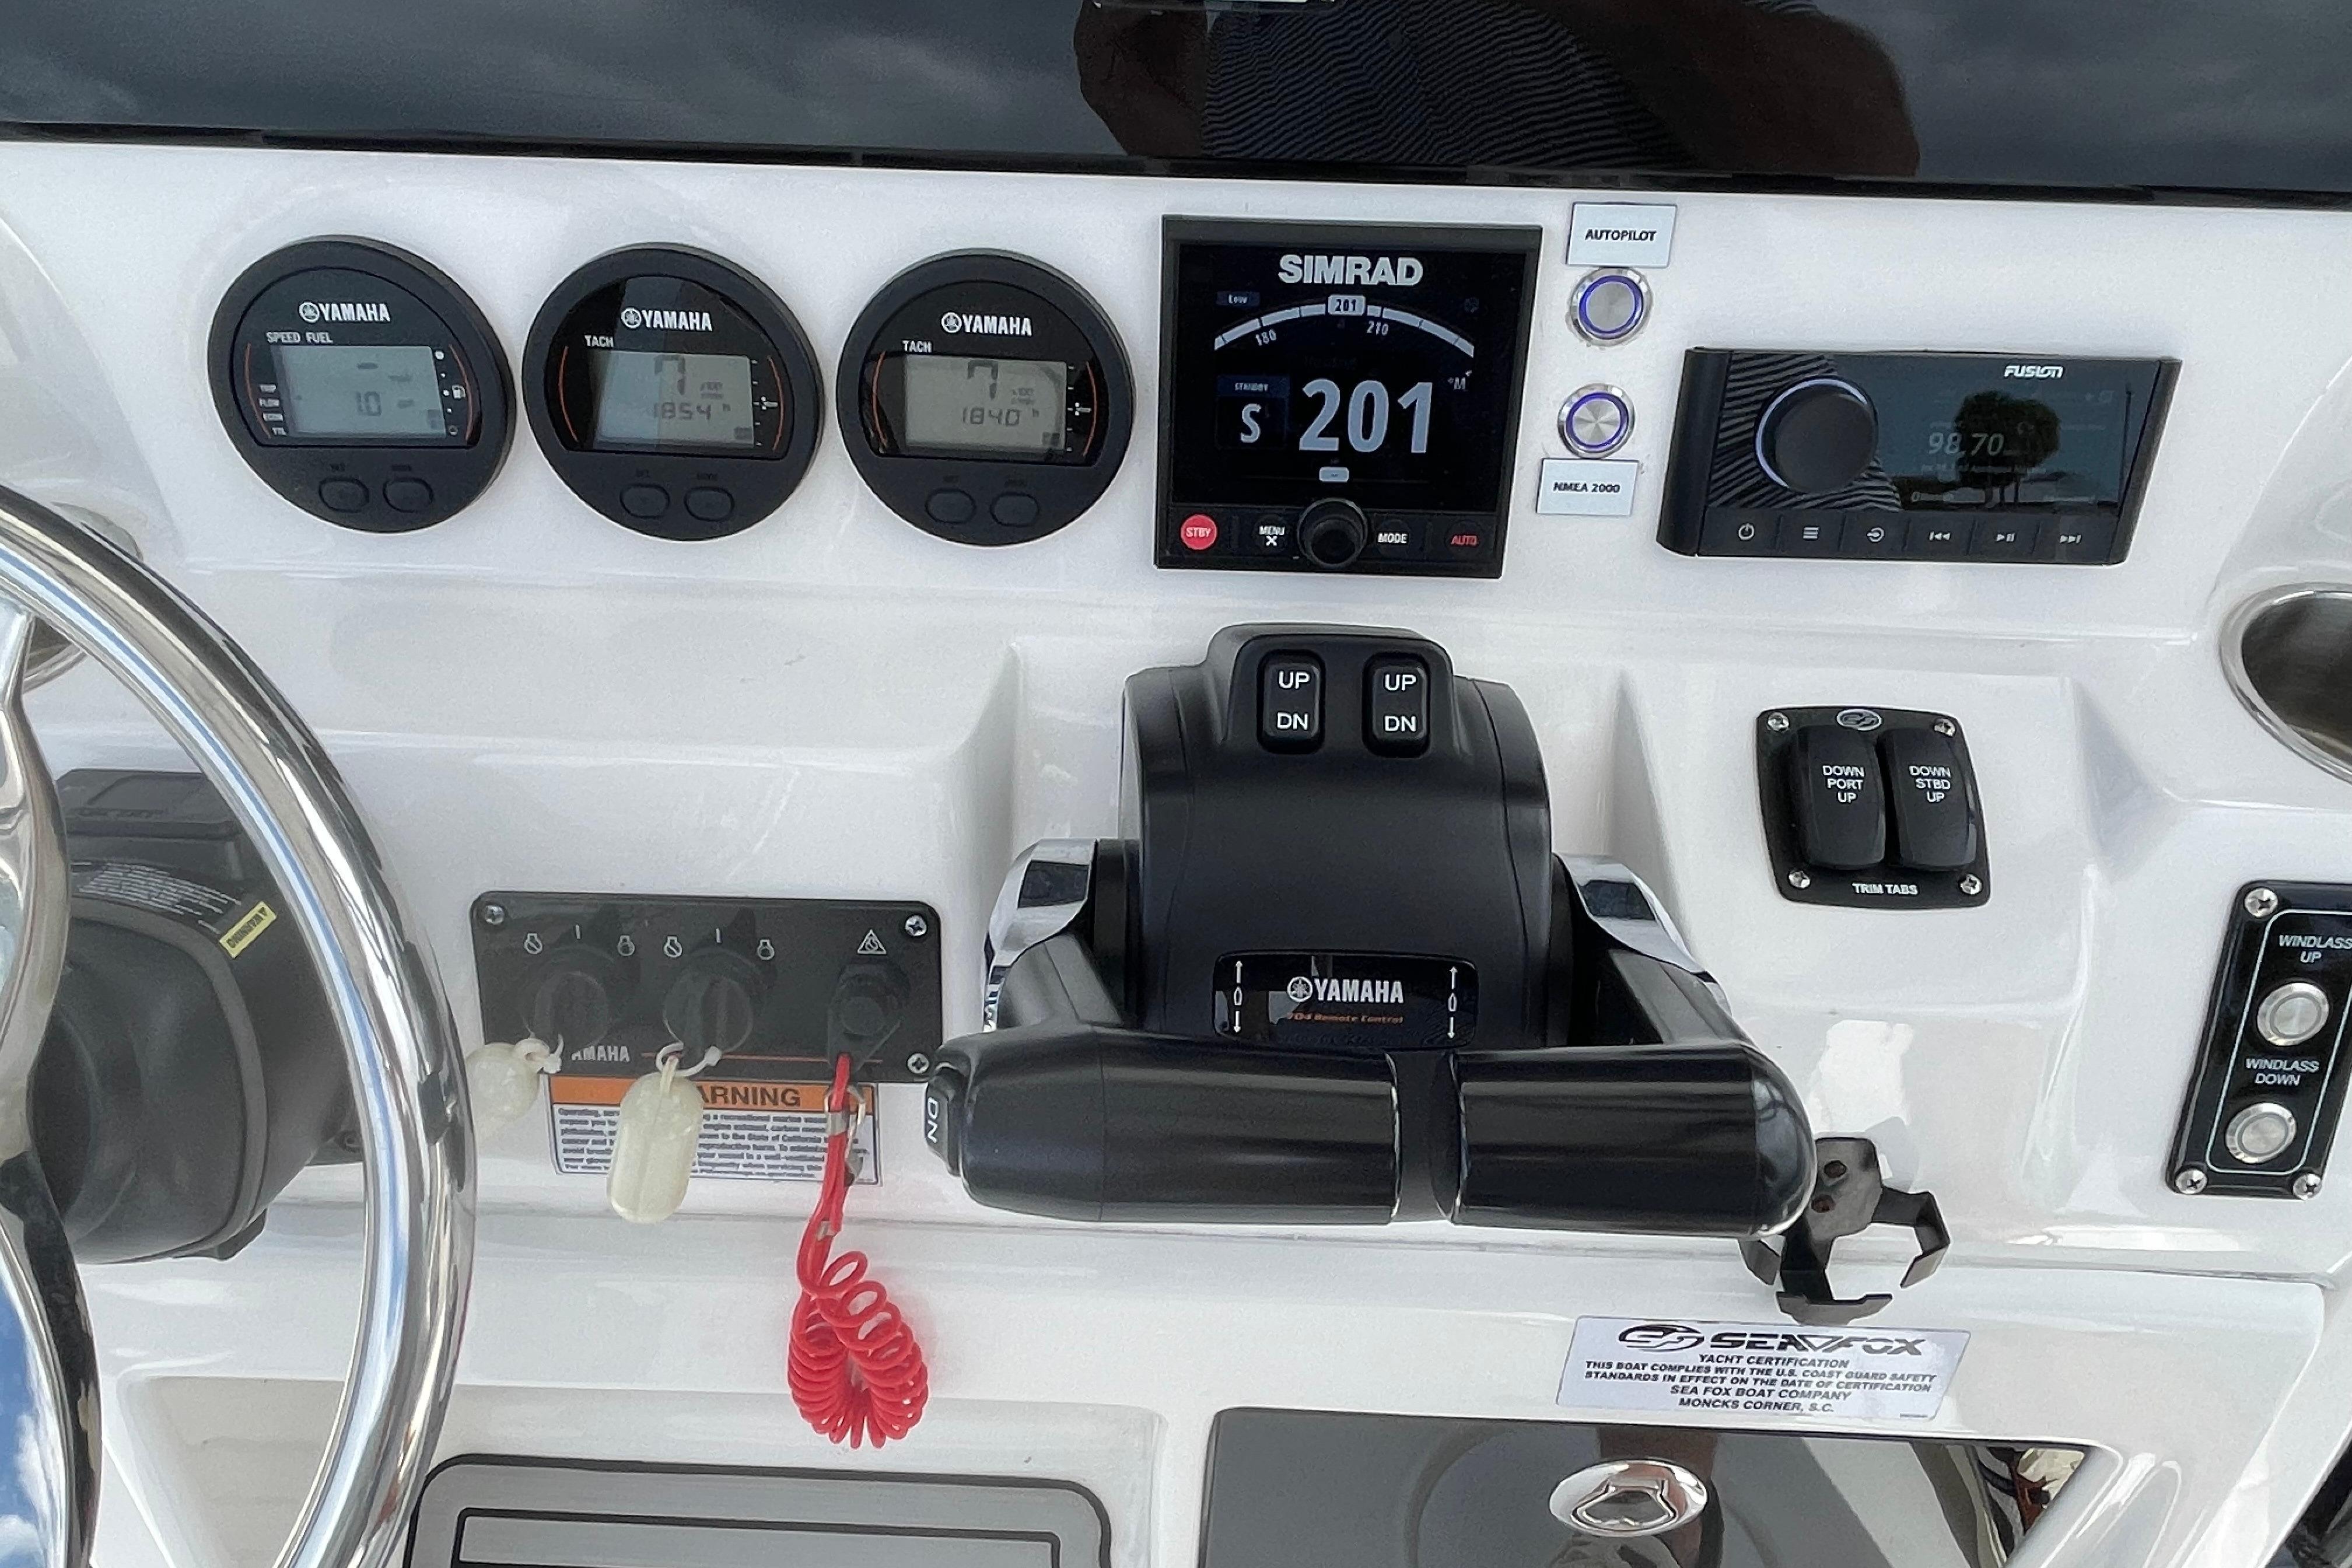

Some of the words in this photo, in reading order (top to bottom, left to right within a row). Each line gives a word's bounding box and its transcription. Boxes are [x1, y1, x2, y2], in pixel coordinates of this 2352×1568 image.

[1585, 229, 1657, 241] AUTOPILOT
[1278, 254, 1423, 286] SIMRAD
[1228, 294, 1247, 303] Low
[1335, 299, 1357, 312] 201
[319, 303, 391, 321] YAMAHA
[642, 310, 713, 331] YAMAHA
[962, 314, 1032, 336] YAMAHA
[1366, 321, 1388, 335] 210
[266, 331, 301, 343] SPEED
[306, 332, 334, 343] FUEL
[584, 335, 614, 348] TACH
[1255, 329, 1276, 346] 180
[902, 340, 932, 353] TACH
[654, 355, 686, 396] 7
[2004, 365, 2064, 378] FUSION
[967, 360, 998, 399] 7
[654, 402, 712, 420] 1854
[963, 407, 1021, 426] 1840
[1298, 378, 1433, 454] 201
[1240, 403, 1261, 443] S
[1553, 482, 1588, 493] NMEA
[1591, 482, 1620, 494] 2000
[1185, 527, 1212, 538] STBY
[1259, 525, 1285, 536] MENU
[1378, 533, 1408, 544] MODE
[1450, 535, 1478, 546] AUTO
[1279, 671, 1310, 689] UP
[1384, 673, 1417, 692] UP
[1277, 713, 1309, 730] DN
[1384, 715, 1416, 732] DN
[1822, 765, 1864, 777] DOWN
[1909, 765, 1951, 778] DOWN
[1827, 778, 1863, 790] PORT
[1916, 778, 1951, 790] STBD
[1838, 792, 1857, 803] UP
[1926, 792, 1945, 803] UP
[1852, 882, 1884, 894] TRIM
[1885, 883, 1918, 895] TABS
[2279, 935, 2352, 949] WINDLASS
[2301, 951, 2322, 963] UP
[1314, 978, 1404, 1003] YAMAHA
[572, 1045, 630, 1062] AMAHA
[2246, 1058, 2319, 1073] WINDLASS
[2255, 1074, 2301, 1086] DOWN
[928, 1097, 939, 1143] DN
[1699, 1354, 1744, 1364] YACHT
[1747, 1356, 1850, 1368] CERTIFICATION
[1586, 1360, 1612, 1370] THIS
[1616, 1362, 1648, 1371] BOAT
[1651, 1364, 1711, 1373] COMPLIES
[1714, 1367, 1746, 1376] WITH
[1749, 1368, 1772, 1377] THE
[1776, 1368, 1798, 1377] U.S.
[1803, 1370, 1840, 1378] COAST
[1845, 1372, 1888, 1380] GUARD
[1889, 1373, 1937, 1382] SAFETY
[1585, 1371, 1658, 1382] STANDARDS
[1662, 1374, 1676, 1382] IN
[1680, 1375, 1727, 1385] EFFECT
[1730, 1377, 1749, 1386] ON
[1752, 1378, 1778, 1387] THE
[1780, 1379, 1813, 1388] DATE
[1815, 1380, 1829, 1388] OF
[1836, 1381, 1931, 1392] CERTIFICATION
[1671, 1385, 1698, 1395] SEA
[1702, 1387, 1732, 1396] FOX
[1735, 1388, 1775, 1398] BOAT
[1779, 1390, 1852, 1400] COMPANY
[1679, 1398, 1739, 1409] MONCKS
[1743, 1400, 1804, 1412] CORNER,
[1809, 1403, 1834, 1412] S.C.
